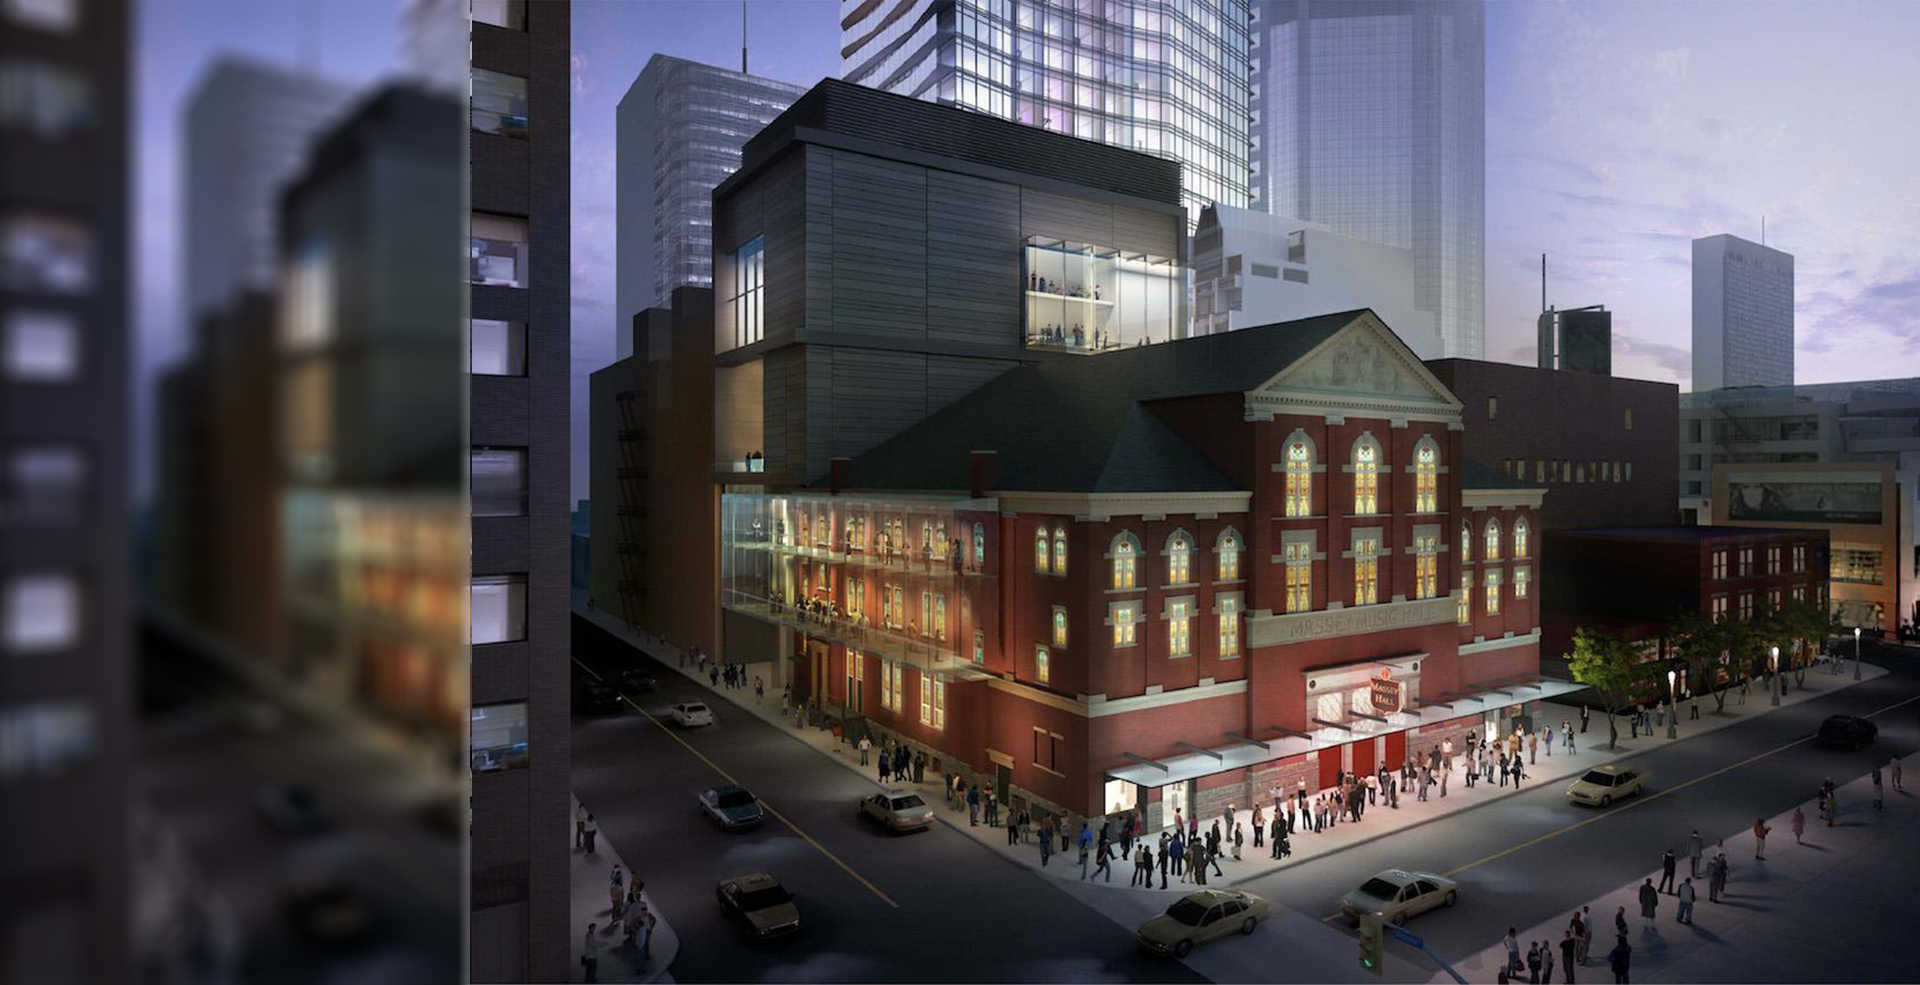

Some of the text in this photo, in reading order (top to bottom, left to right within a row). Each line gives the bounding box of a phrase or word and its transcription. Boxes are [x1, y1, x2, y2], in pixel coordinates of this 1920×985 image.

[1290, 603, 1434, 638] MASSEY MUSIC HALL
[1373, 683, 1399, 695] MASSEY
[1375, 694, 1395, 706] HALL
